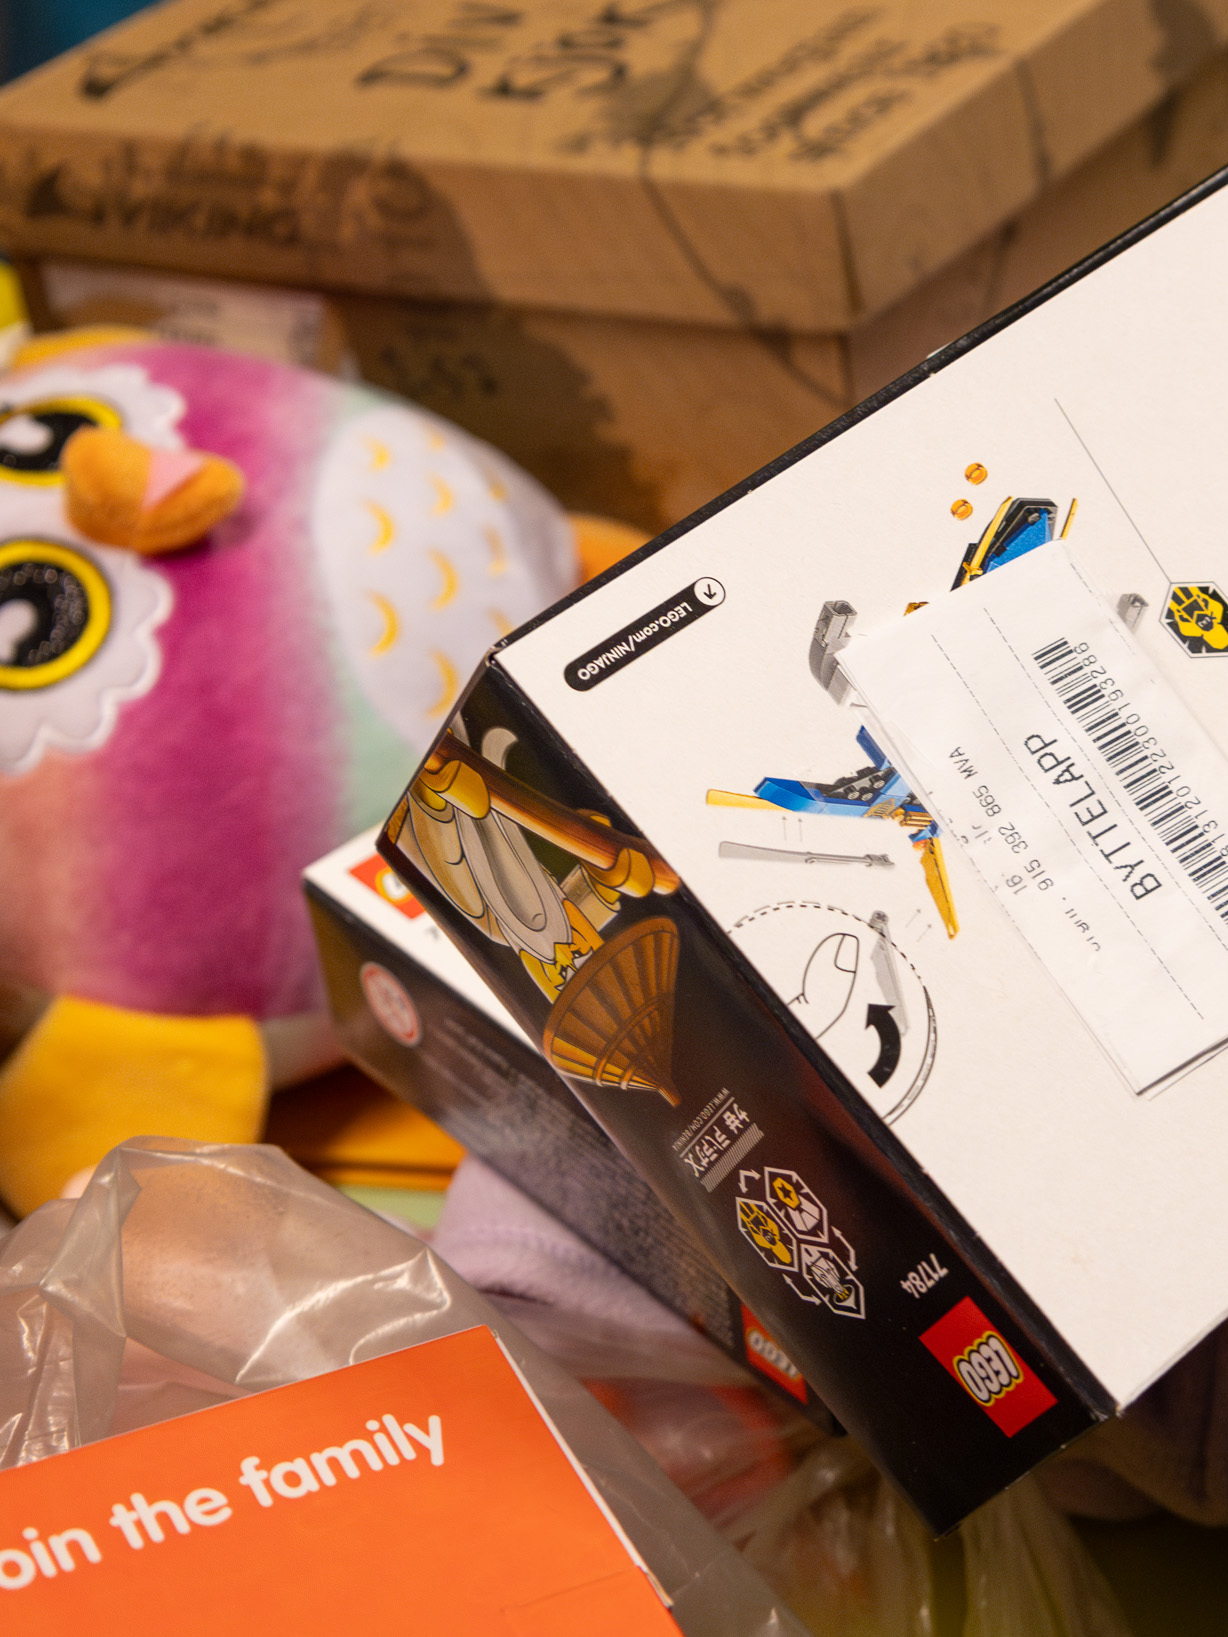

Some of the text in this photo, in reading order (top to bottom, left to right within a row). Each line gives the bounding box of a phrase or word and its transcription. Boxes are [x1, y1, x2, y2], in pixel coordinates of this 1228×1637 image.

[577, 601, 693, 681] LEGO.com/NINJAGO
[949, 746, 978, 780] MVA
[972, 785, 1002, 818] 865
[1024, 734, 1162, 900] BYTTELAPP
[998, 822, 1029, 855] 392
[1024, 859, 1054, 892] 915
[900, 1252, 949, 1299] 71784
[955, 1332, 1022, 1405] LEGO
[109, 1487, 232, 1550] the
[239, 1414, 444, 1508] family
